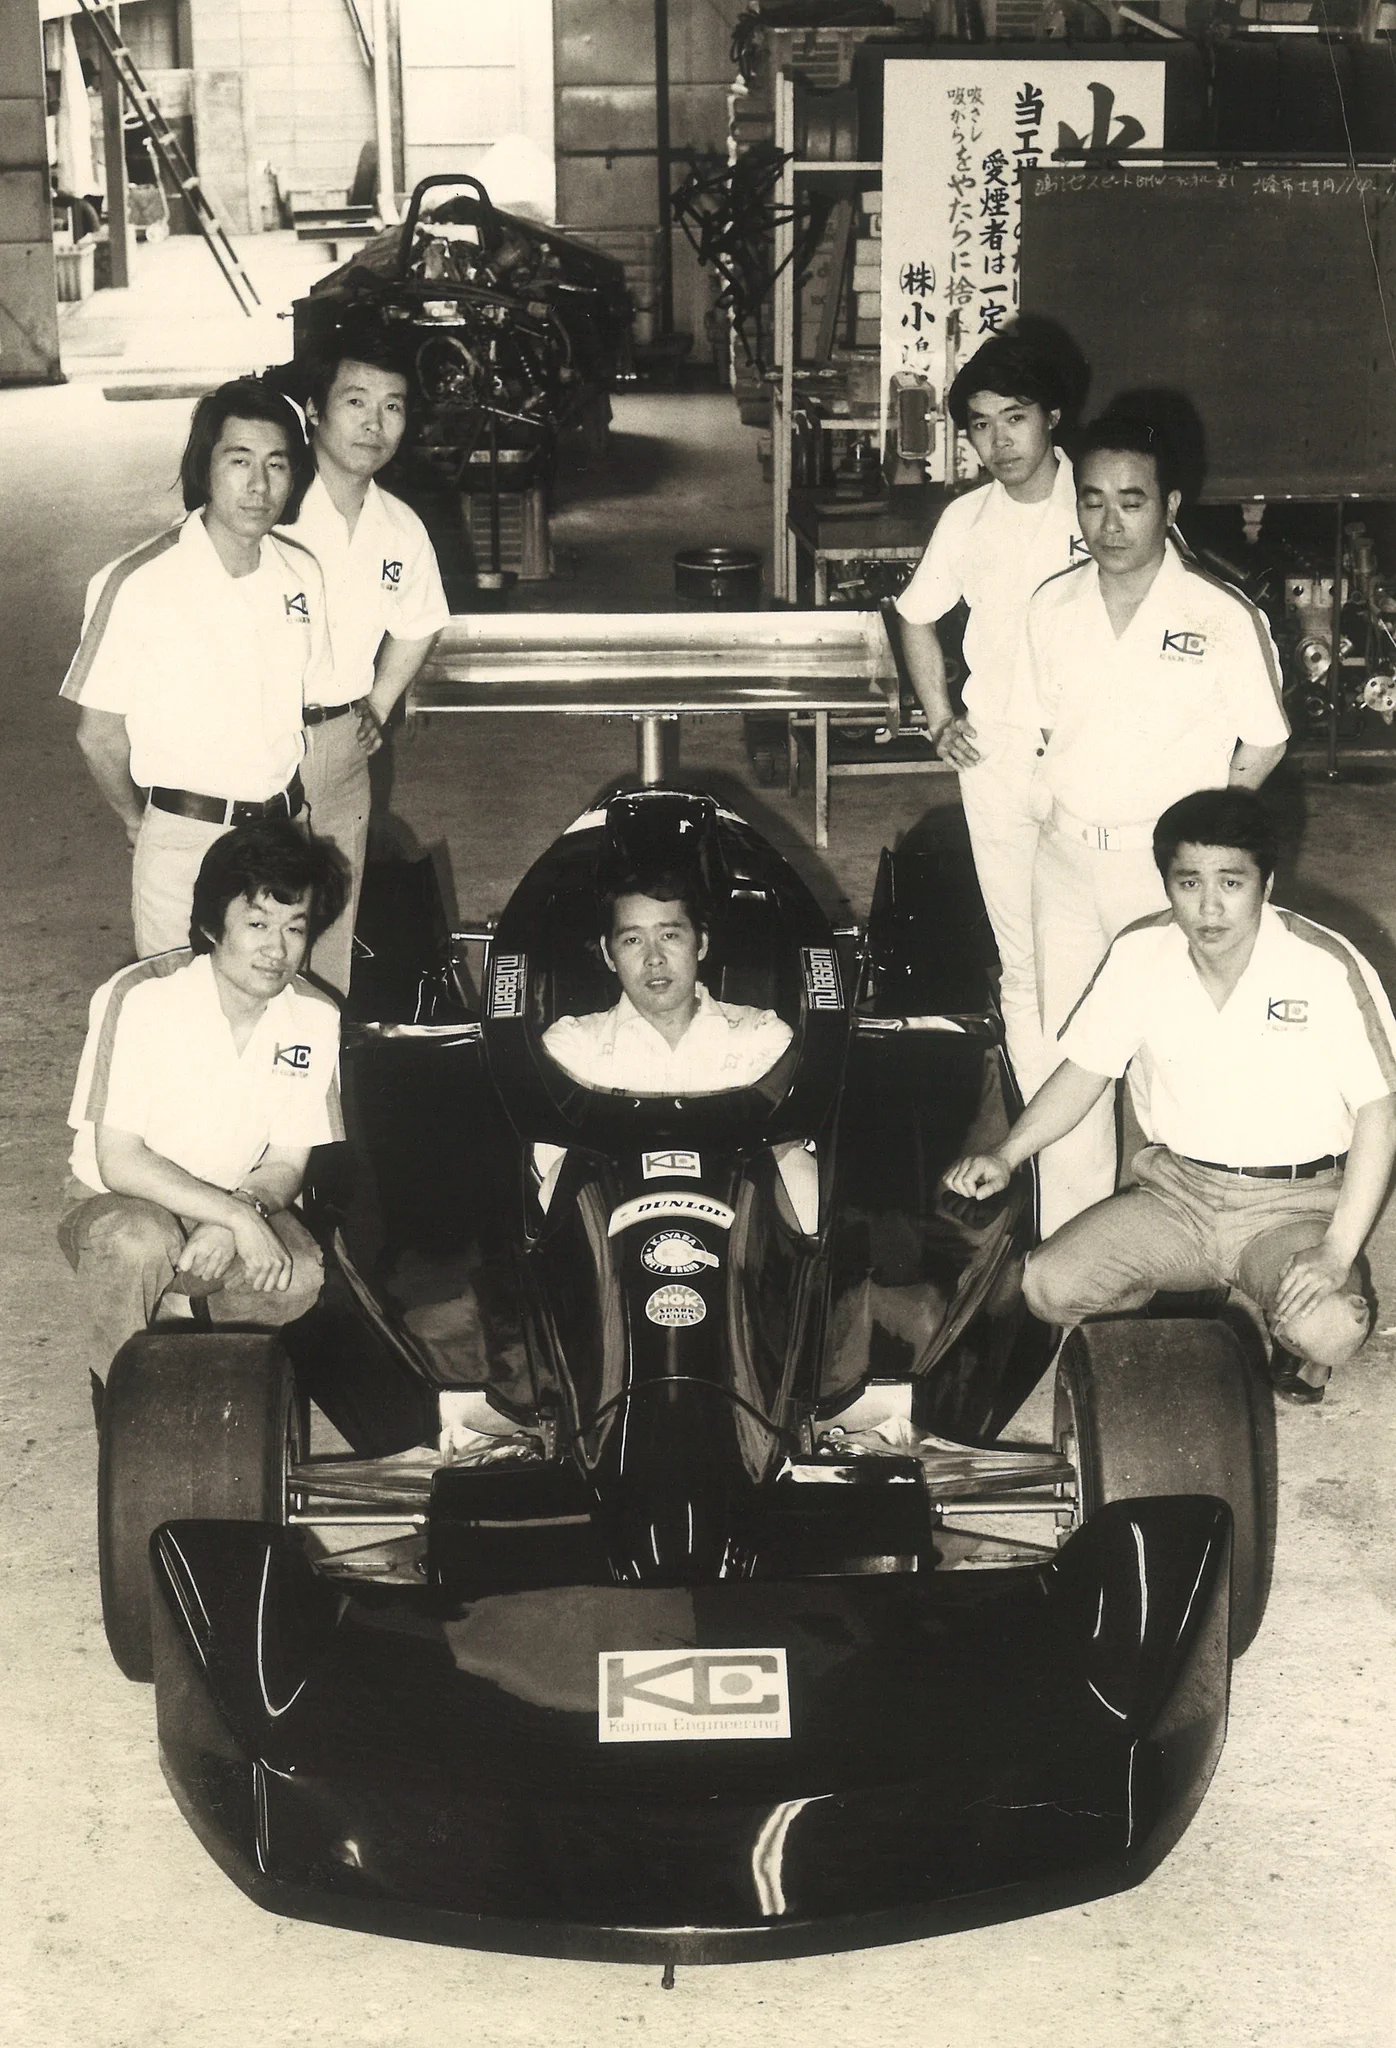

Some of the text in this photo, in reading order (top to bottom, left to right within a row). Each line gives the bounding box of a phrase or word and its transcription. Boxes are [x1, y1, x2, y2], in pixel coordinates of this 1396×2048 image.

[637, 1200, 727, 1217] DUNLOP
[650, 1232, 697, 1246] KAYABA
[670, 1262, 700, 1273] BRAND
[609, 1717, 780, 1734] Kojima Engineering
